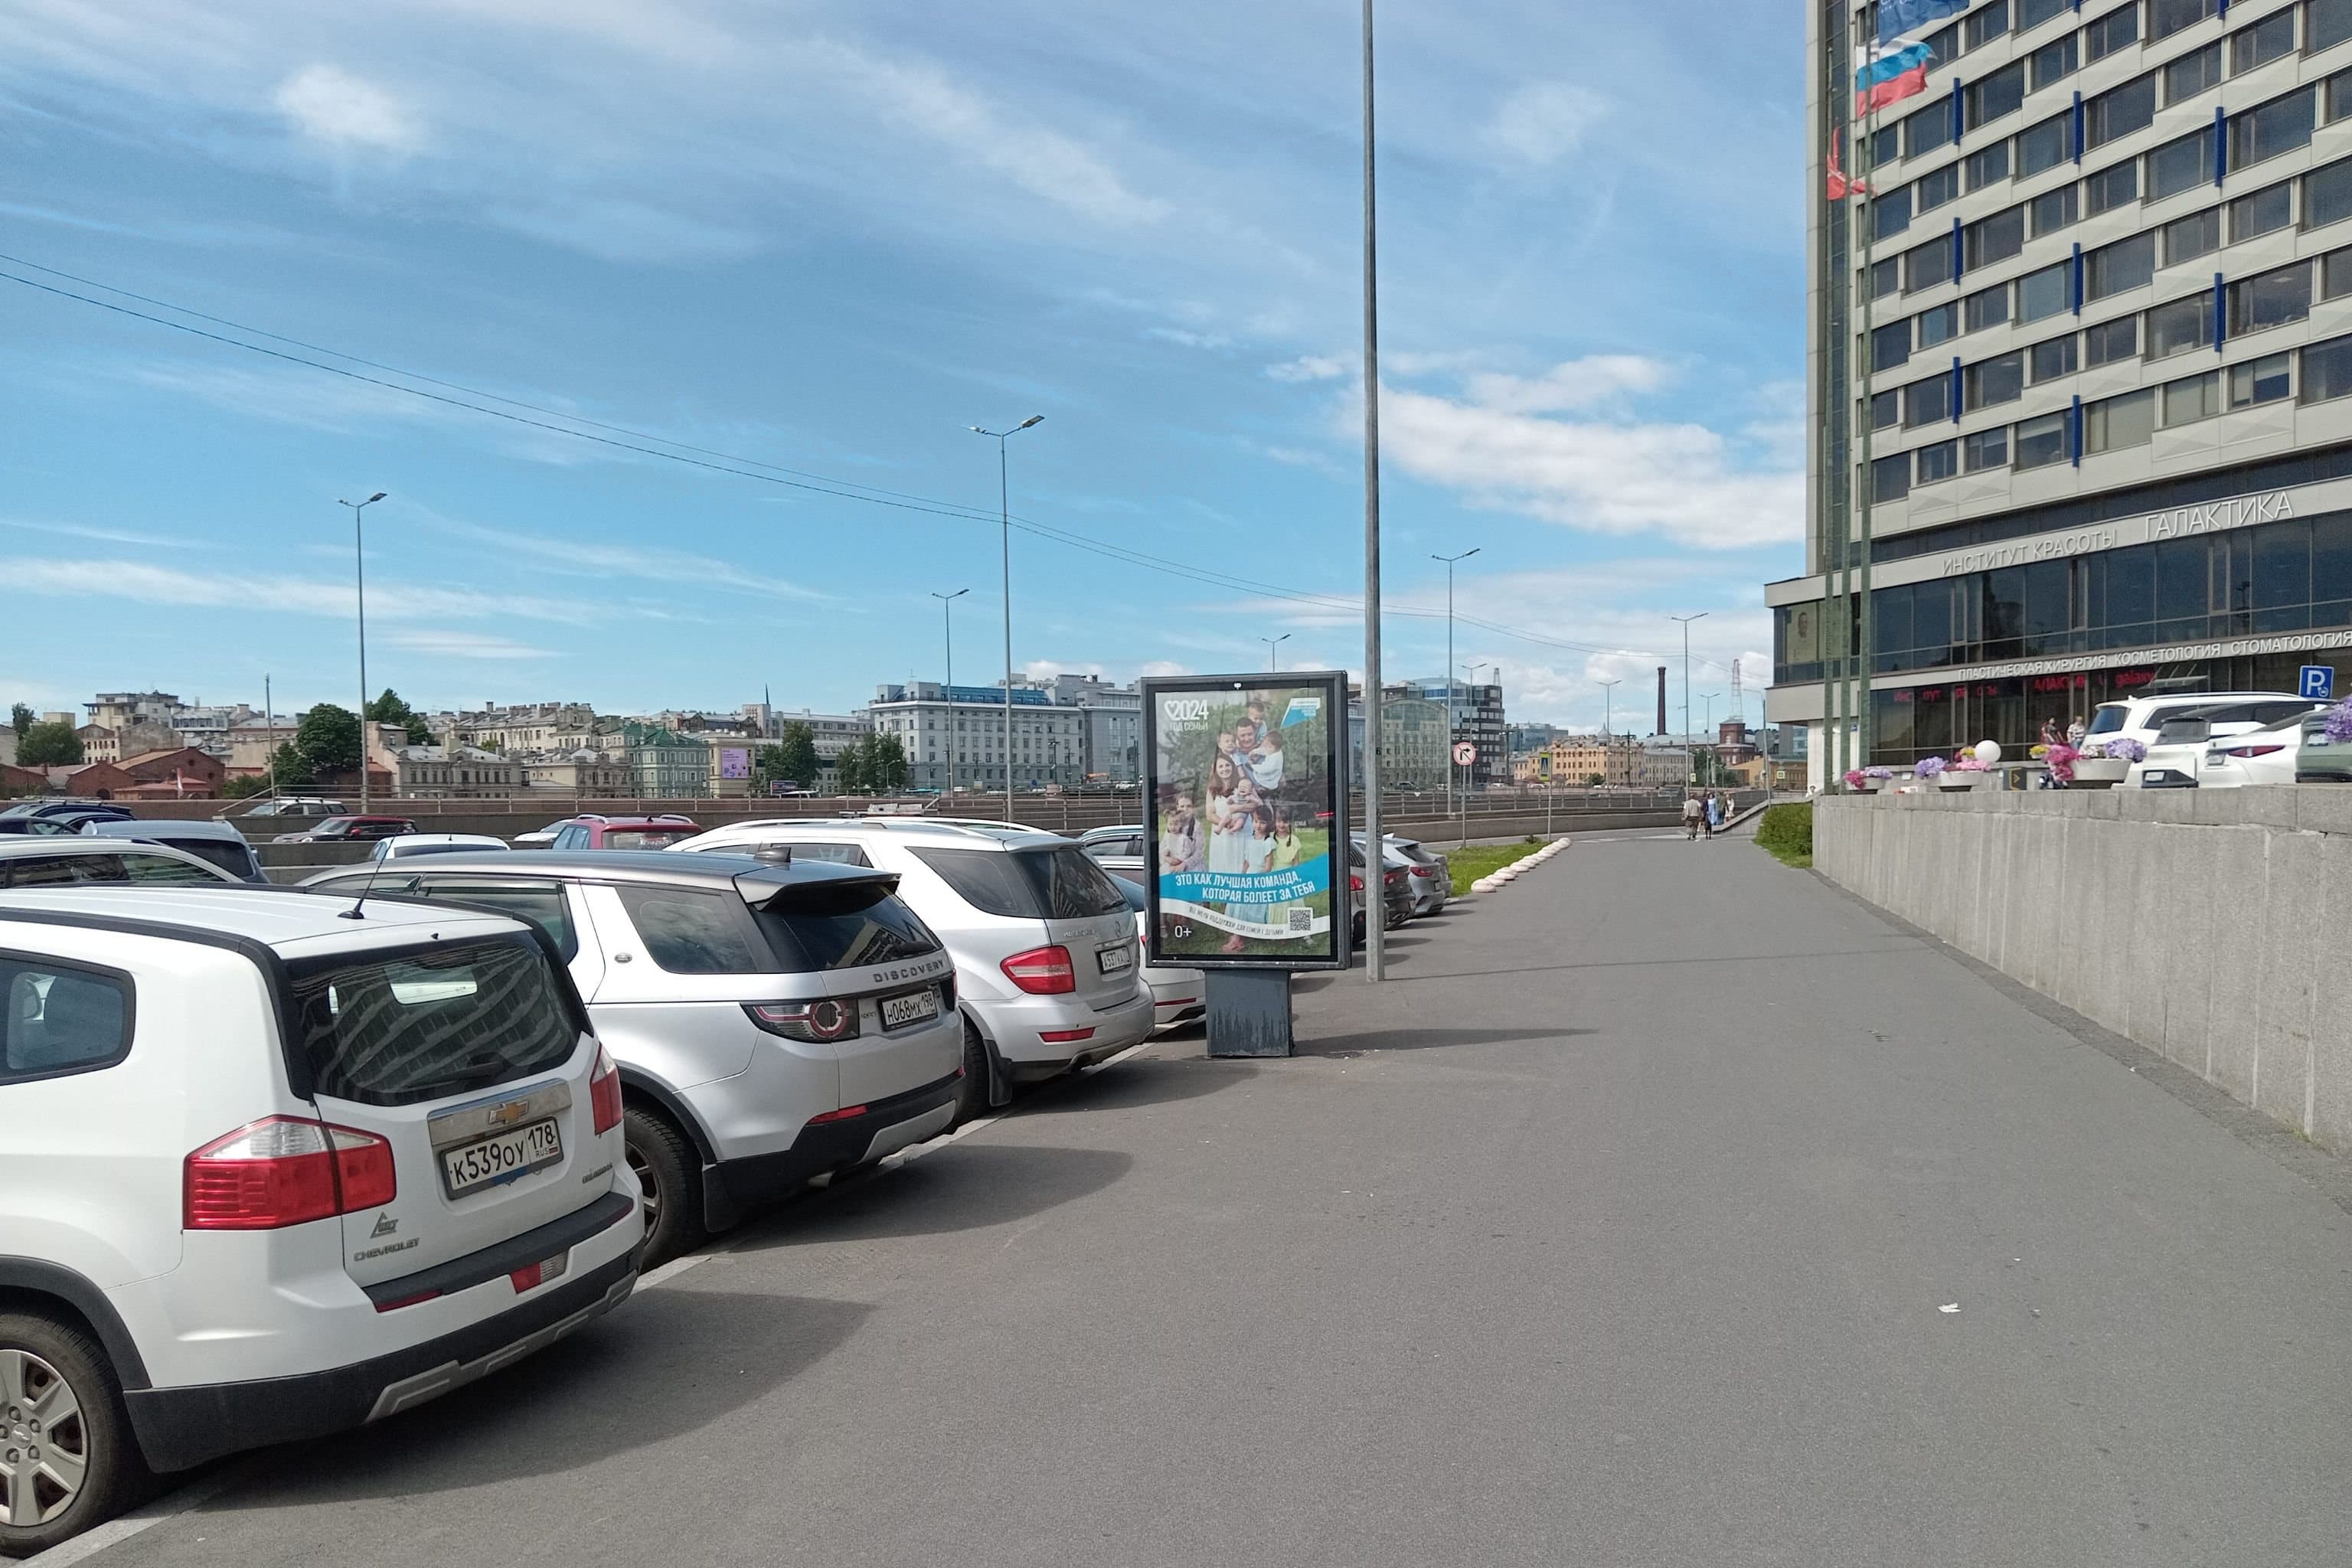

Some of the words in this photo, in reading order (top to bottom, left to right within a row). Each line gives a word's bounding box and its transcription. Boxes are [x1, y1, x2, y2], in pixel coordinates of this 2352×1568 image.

[1942, 545, 2027, 575] ИНСТИТУТ
[2034, 529, 2117, 560] КРАСОТЫ
[2145, 491, 2295, 541] ГАЛАКТИКА
[1958, 662, 2043, 680] ПЛАСТИЧЕСКАЯ
[2044, 655, 2106, 672] ХИРУРГИЯ
[2115, 643, 2221, 665] КОСМЕТОЛОГИЯ
[1164, 699, 1209, 720] 2024
[1175, 874, 1192, 887] ЭТО
[1194, 874, 1211, 886] КАК
[1213, 875, 1253, 889] ЛУЧШАЯ
[1254, 871, 1302, 888] КОМАНДА,
[1202, 887, 1242, 902] КОТОРАЯ
[1243, 891, 1277, 903] БОЛЕЕТ
[1279, 889, 1292, 901] ЗА
[1293, 880, 1315, 898] ТЕБЯ
[1174, 925, 1192, 939] 0+
[873, 959, 944, 983] DISCOVERY
[887, 1000, 923, 1024] Н068МХ
[453, 1140, 524, 1184] К539ОУ
[528, 1124, 555, 1150] 178
[535, 1148, 549, 1158] RUS
